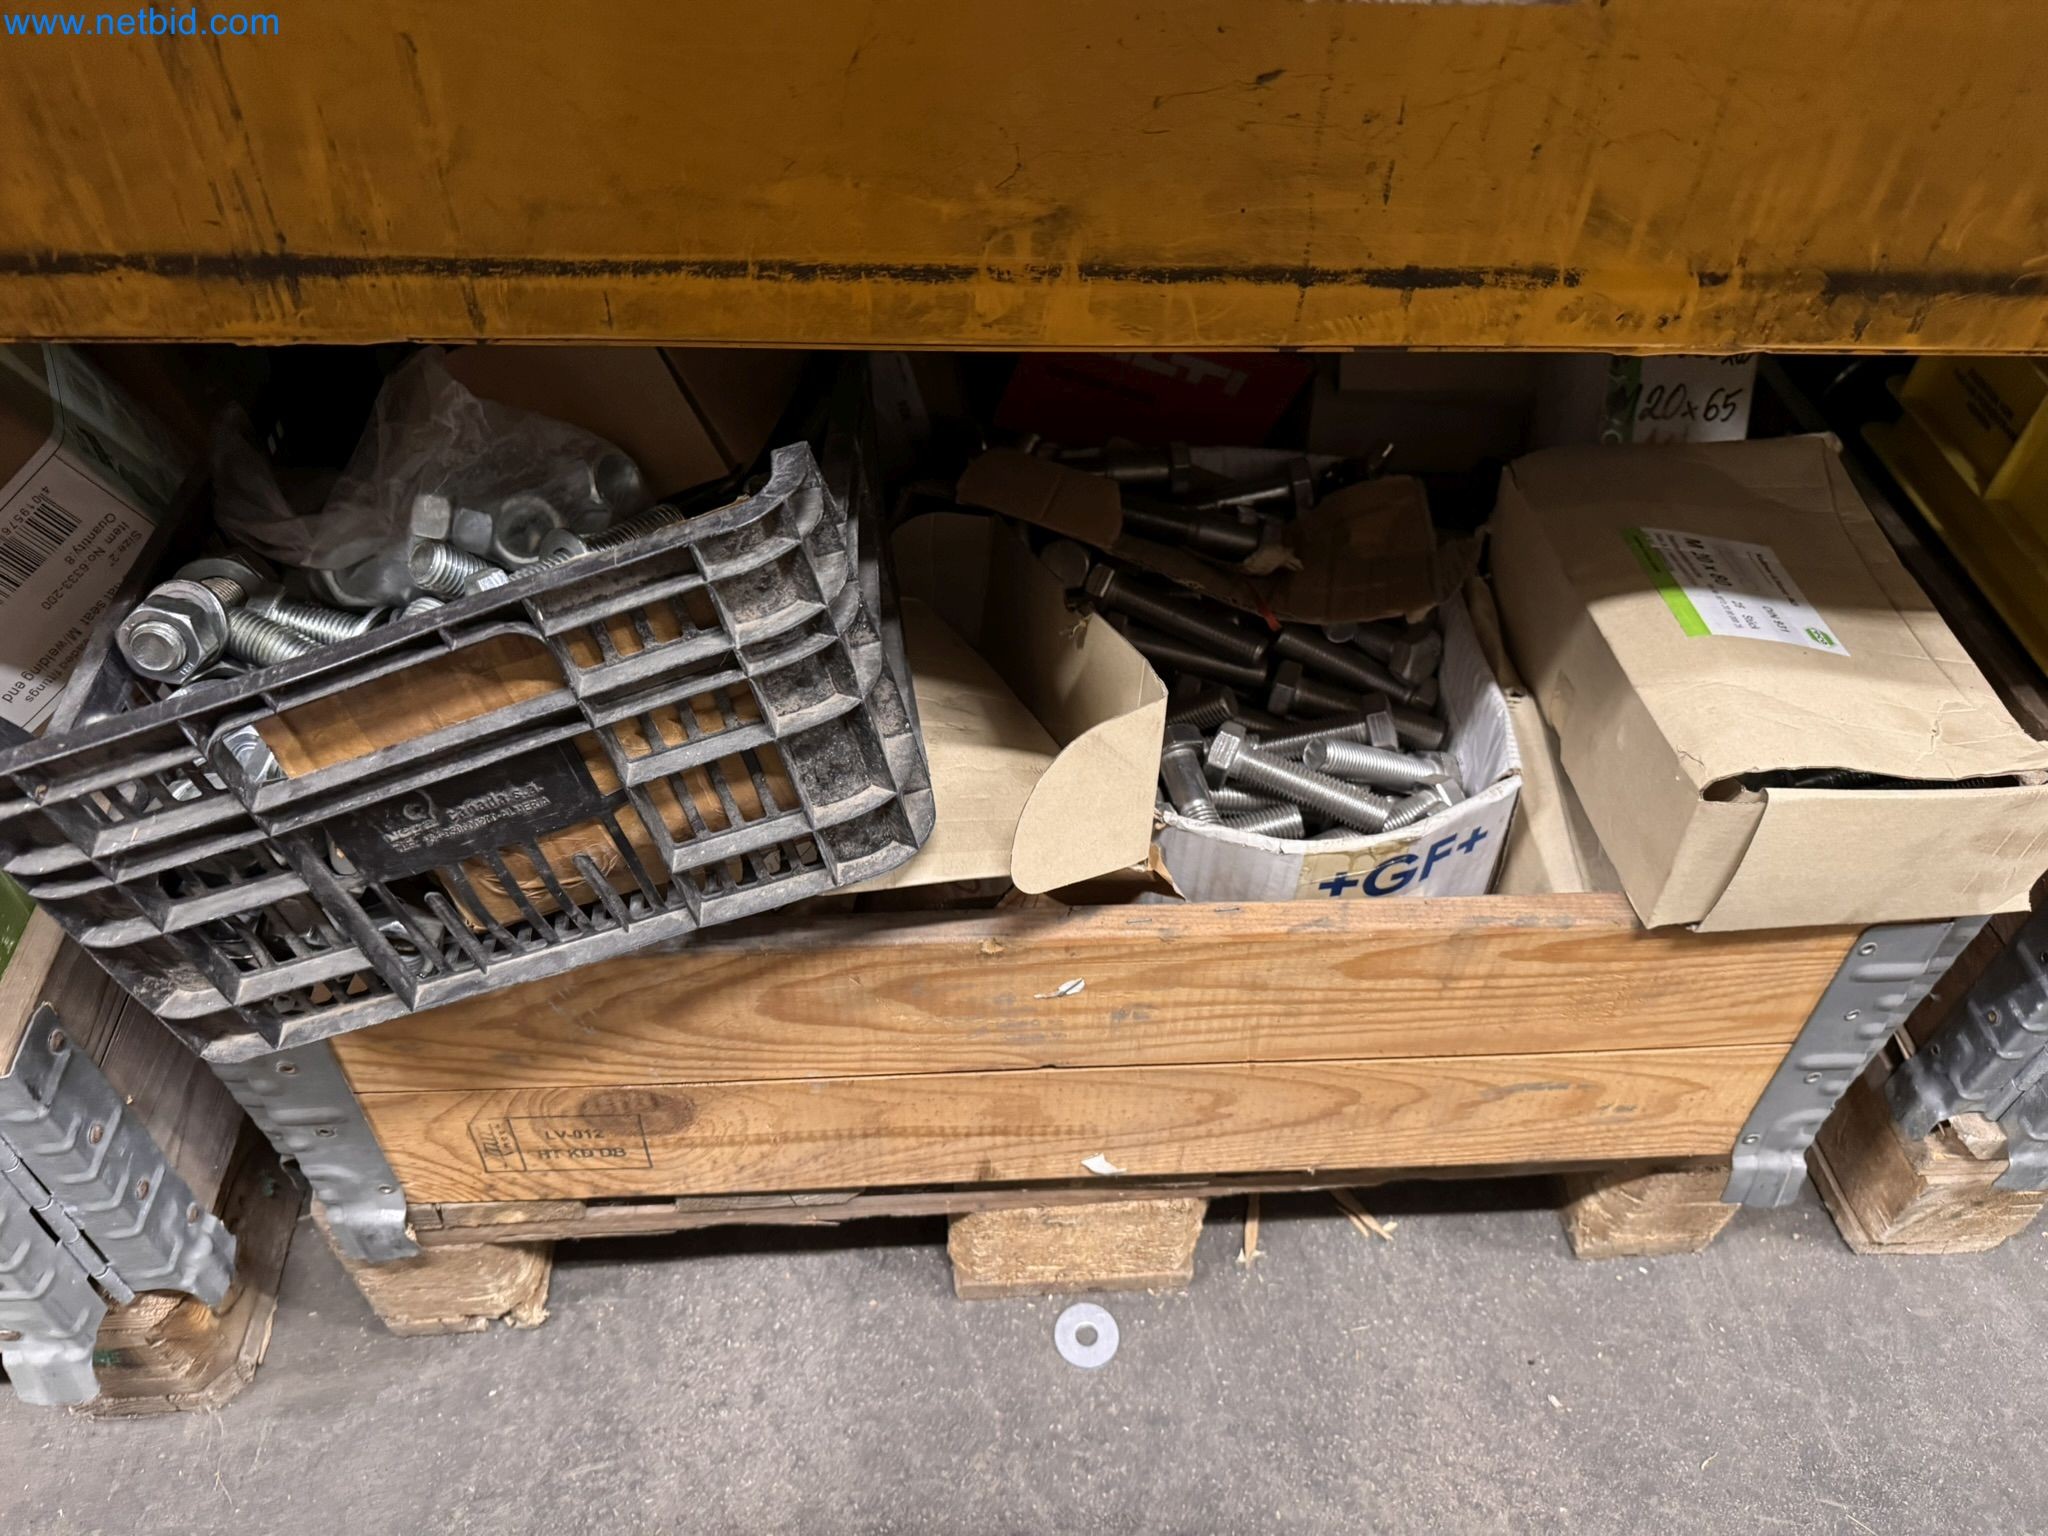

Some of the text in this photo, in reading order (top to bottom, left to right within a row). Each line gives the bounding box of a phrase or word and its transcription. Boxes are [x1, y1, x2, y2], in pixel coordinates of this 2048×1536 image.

[104, 521, 130, 544] Item
[1, 680, 26, 704] end
[545, 1128, 606, 1142] LV-012
